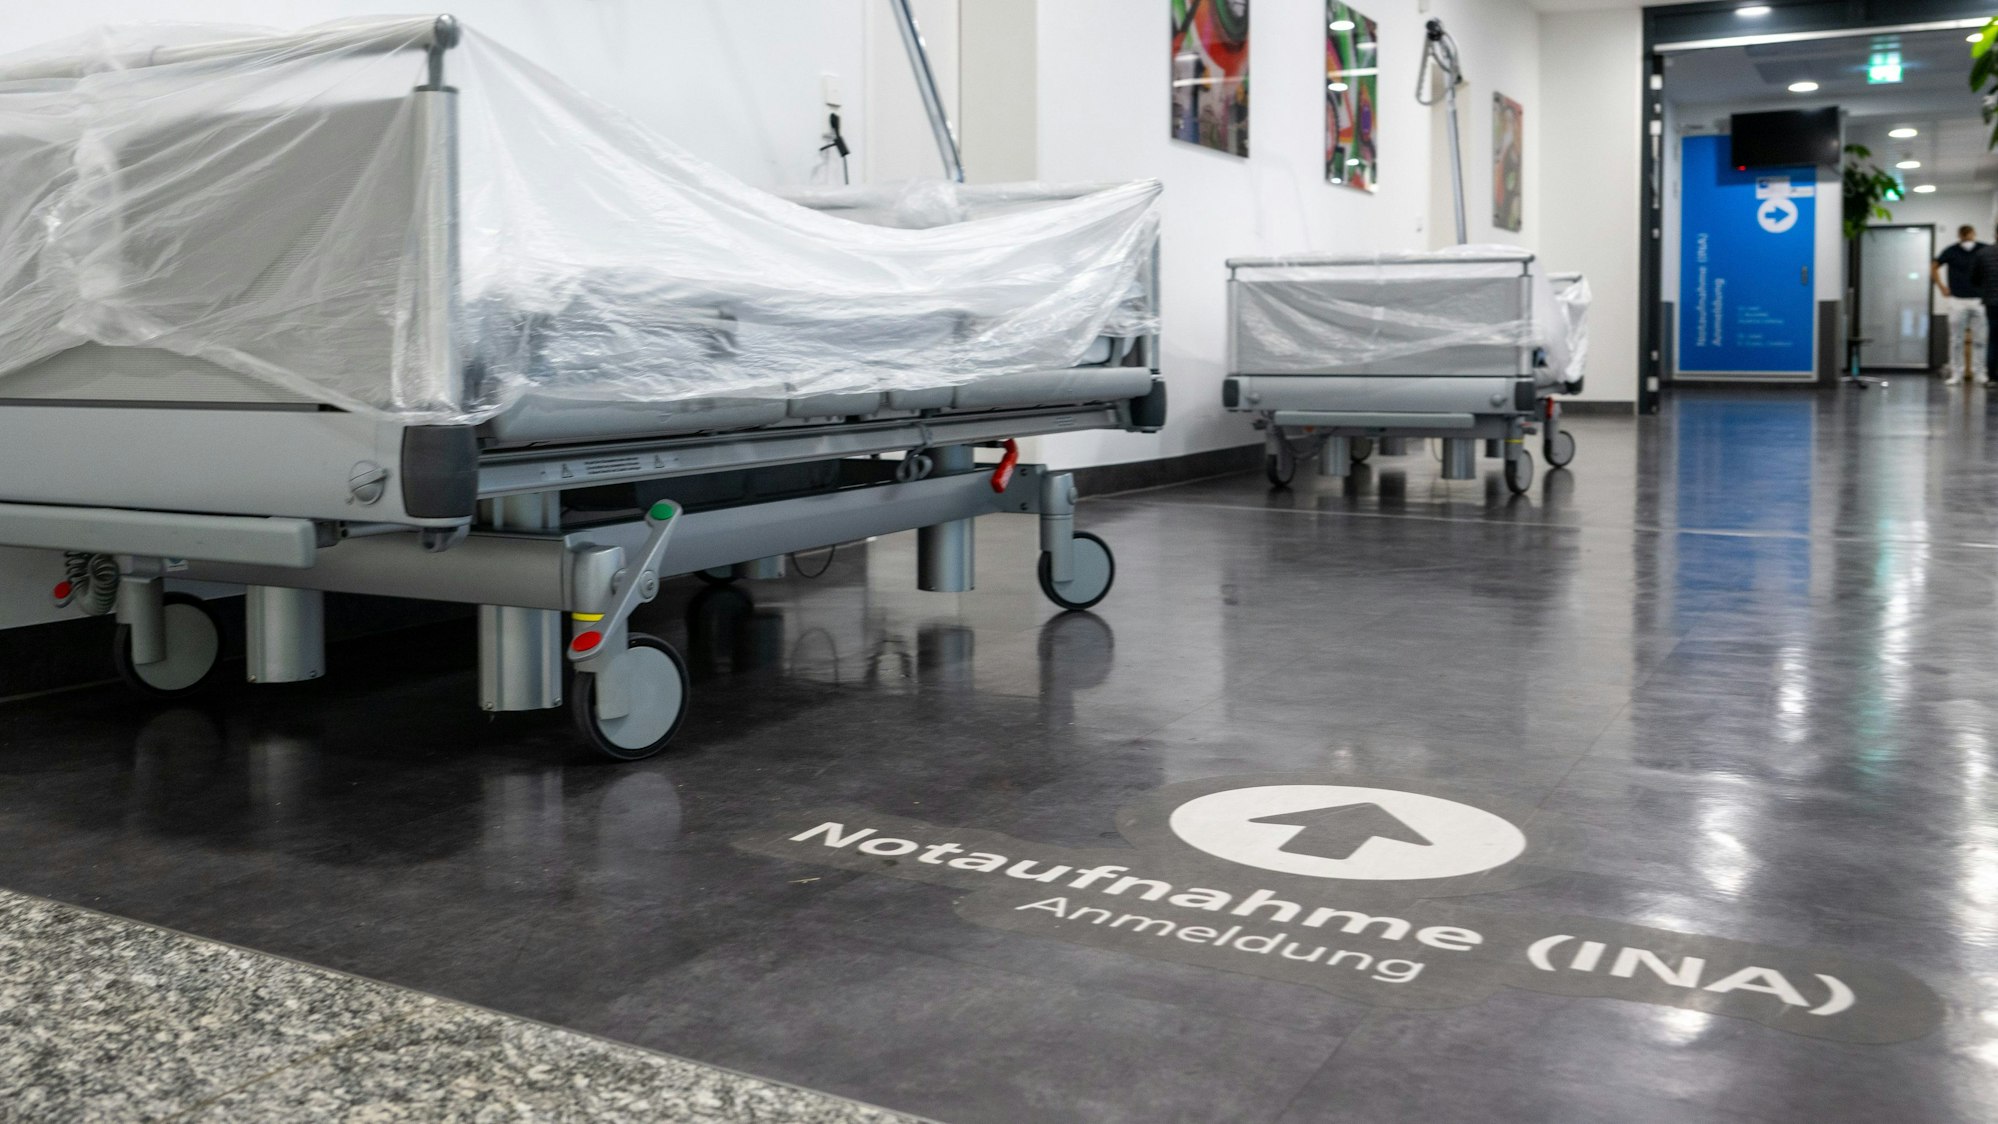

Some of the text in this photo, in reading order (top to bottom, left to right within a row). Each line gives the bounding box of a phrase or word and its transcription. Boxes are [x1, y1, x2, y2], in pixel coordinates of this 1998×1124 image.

[789, 821, 1856, 1016] Notaufnahme (INA)
[1014, 895, 1426, 984] Anmeldung
